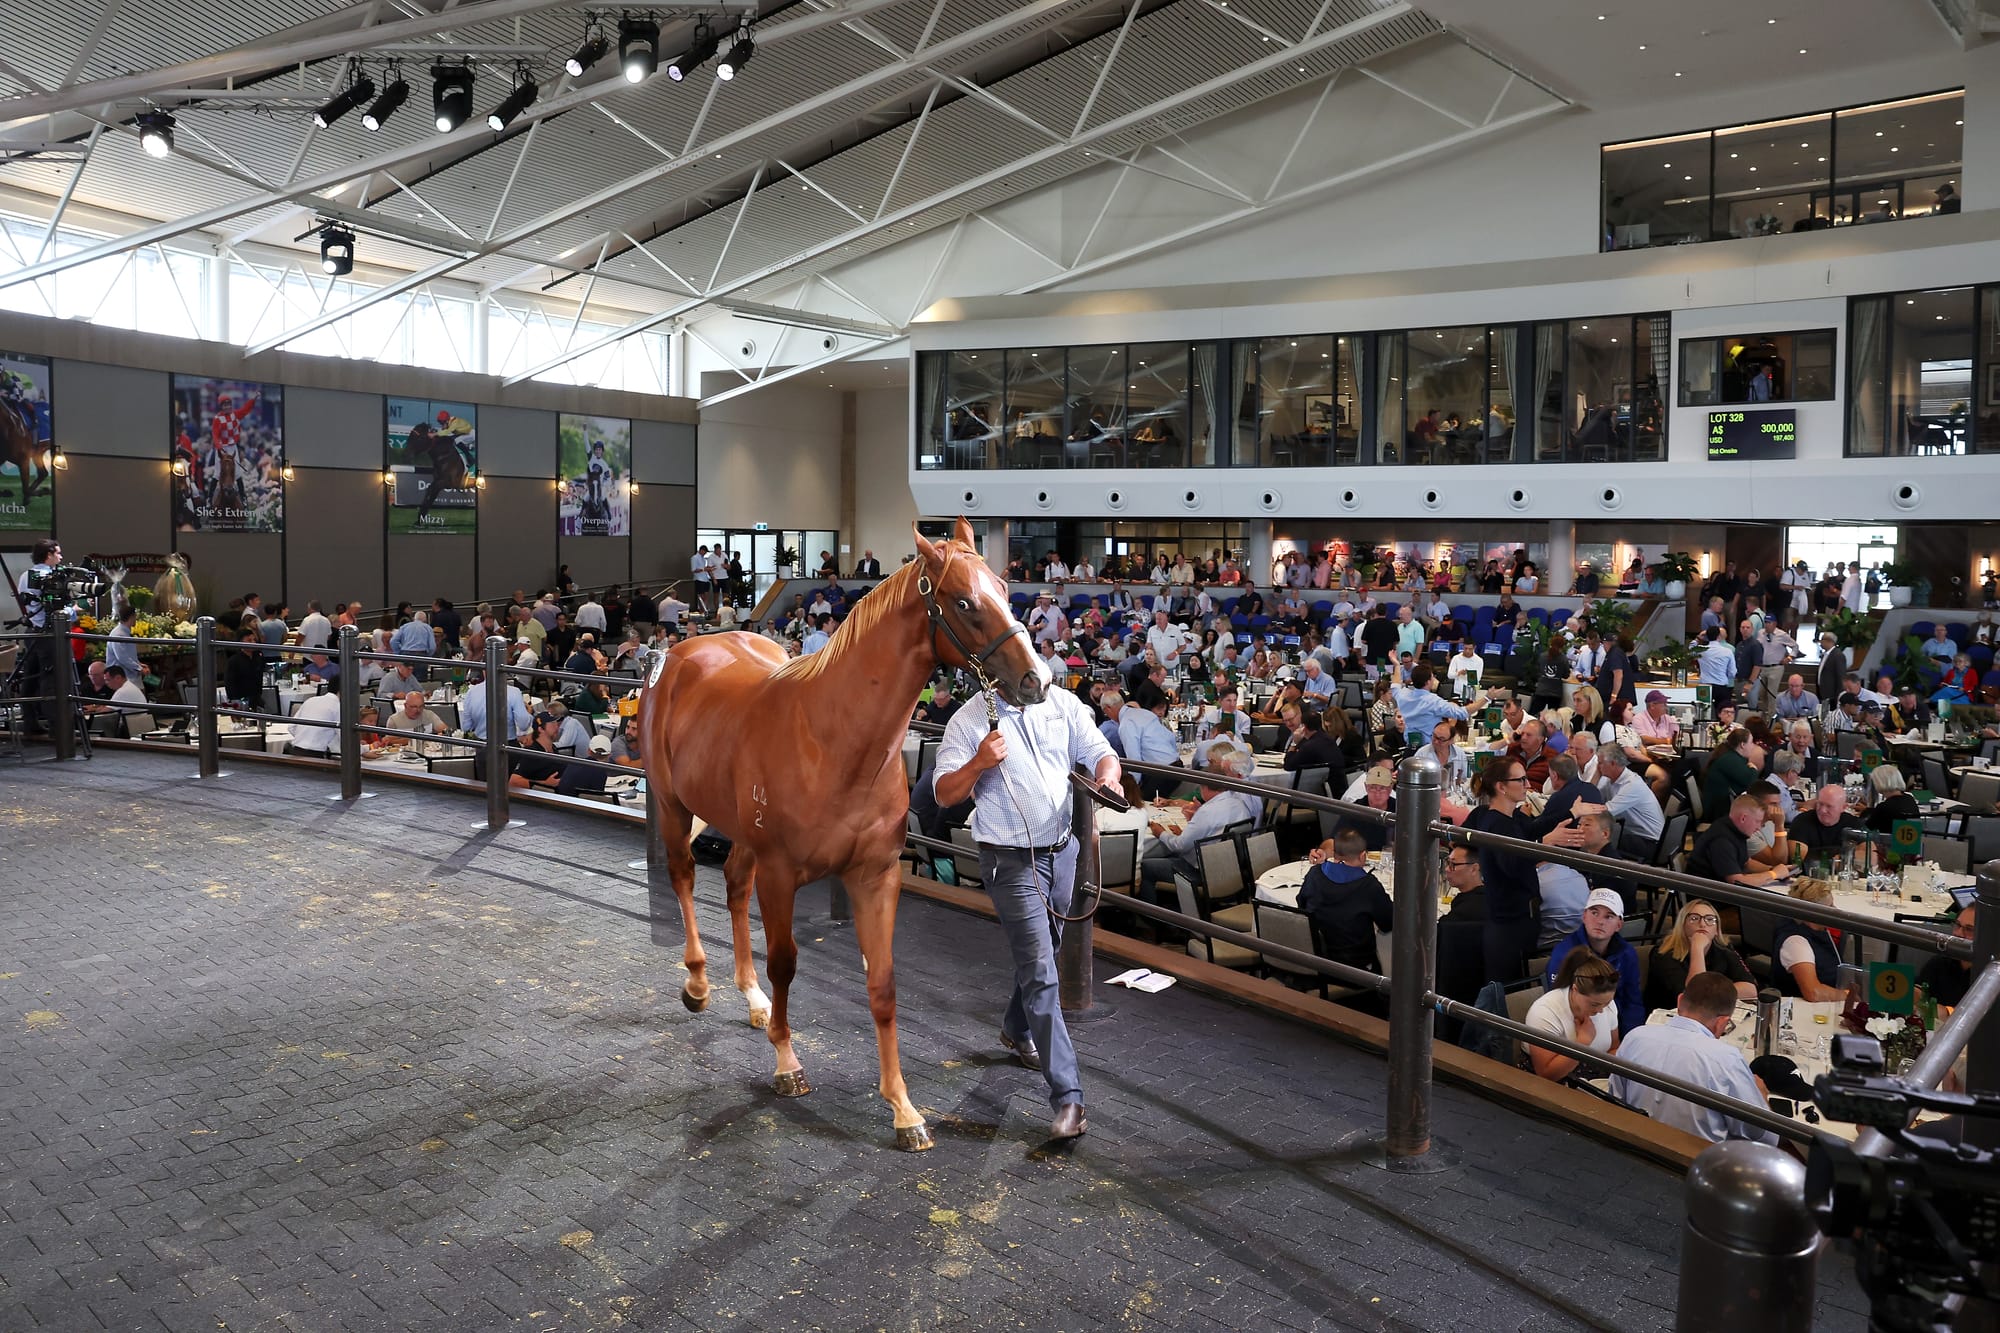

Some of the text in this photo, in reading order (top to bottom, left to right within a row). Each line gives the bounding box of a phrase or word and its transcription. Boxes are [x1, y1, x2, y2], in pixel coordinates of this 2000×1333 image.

[1710, 413, 1744, 423] LOT 328
[1712, 423, 1794, 435] A$ 300,000
[1709, 436, 1723, 444] USD
[0, 501, 26, 514] tcha
[196, 506, 223, 518] She's
[420, 514, 445, 525] Mizzy
[580, 516, 611, 526] Overpass
[755, 810, 764, 829] 2
[1886, 975, 1896, 994] 3
